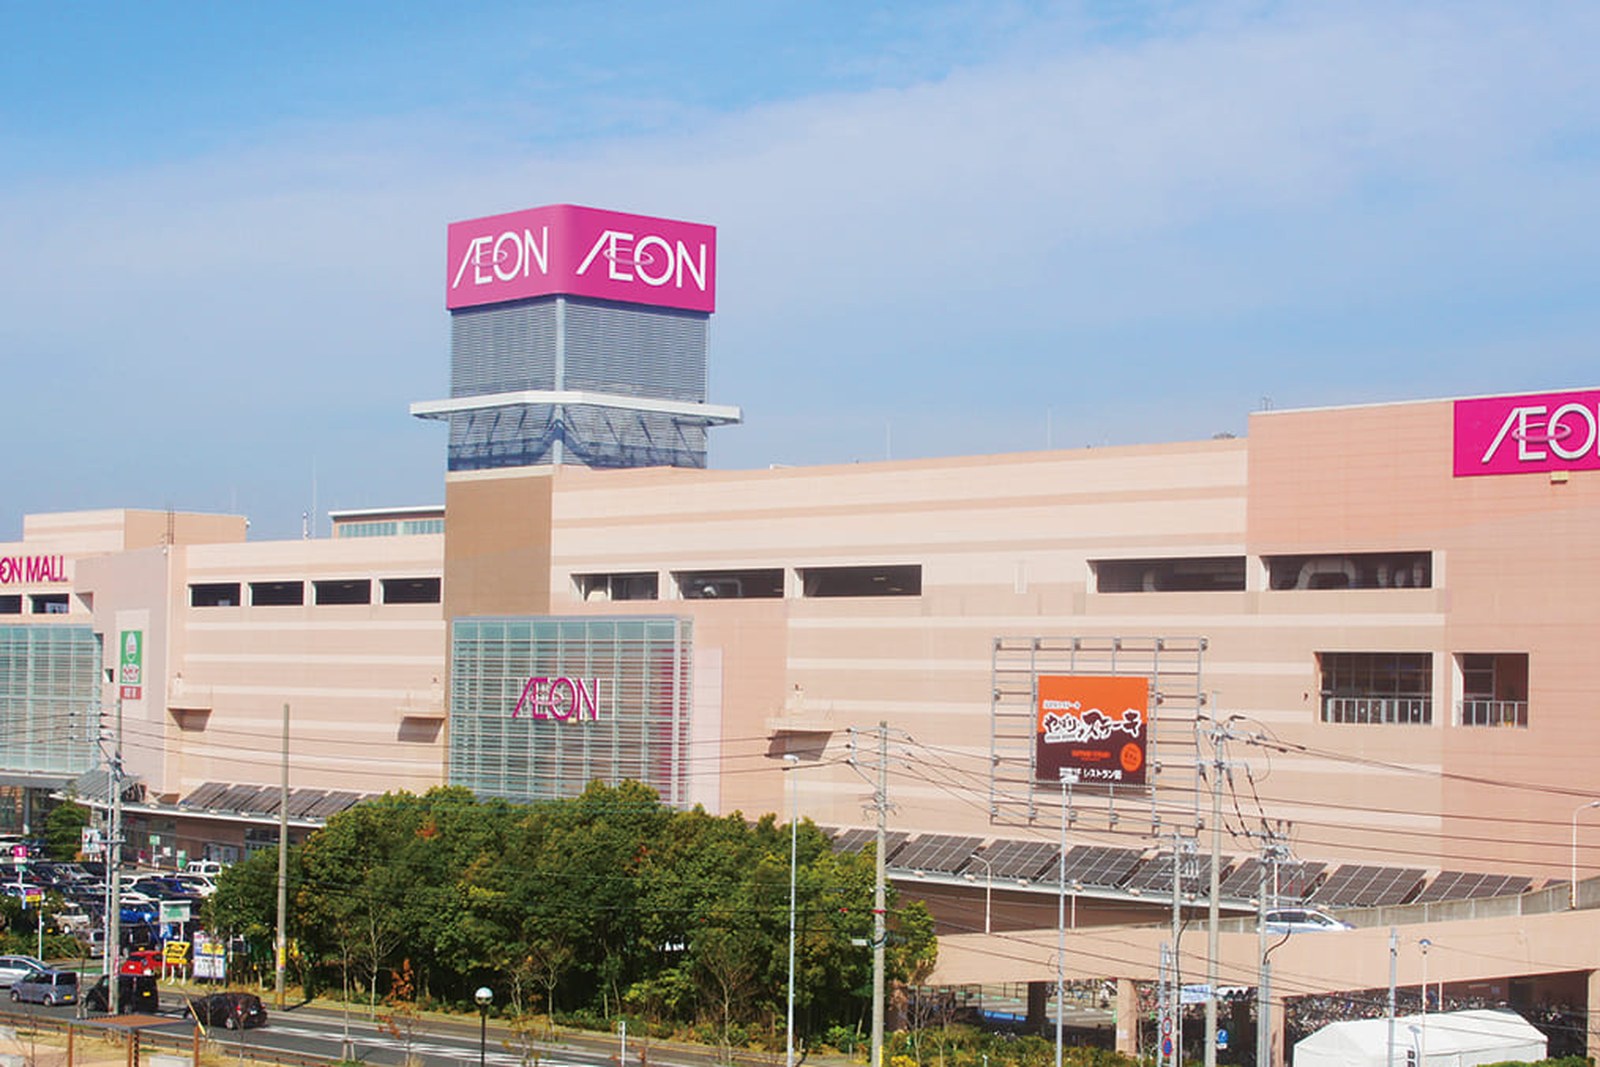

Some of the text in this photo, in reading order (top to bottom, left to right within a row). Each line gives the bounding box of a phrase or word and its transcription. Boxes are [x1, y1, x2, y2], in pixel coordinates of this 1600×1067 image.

[1481, 402, 1600, 463] ÆO
[0, 555, 68, 583] ON MALL
